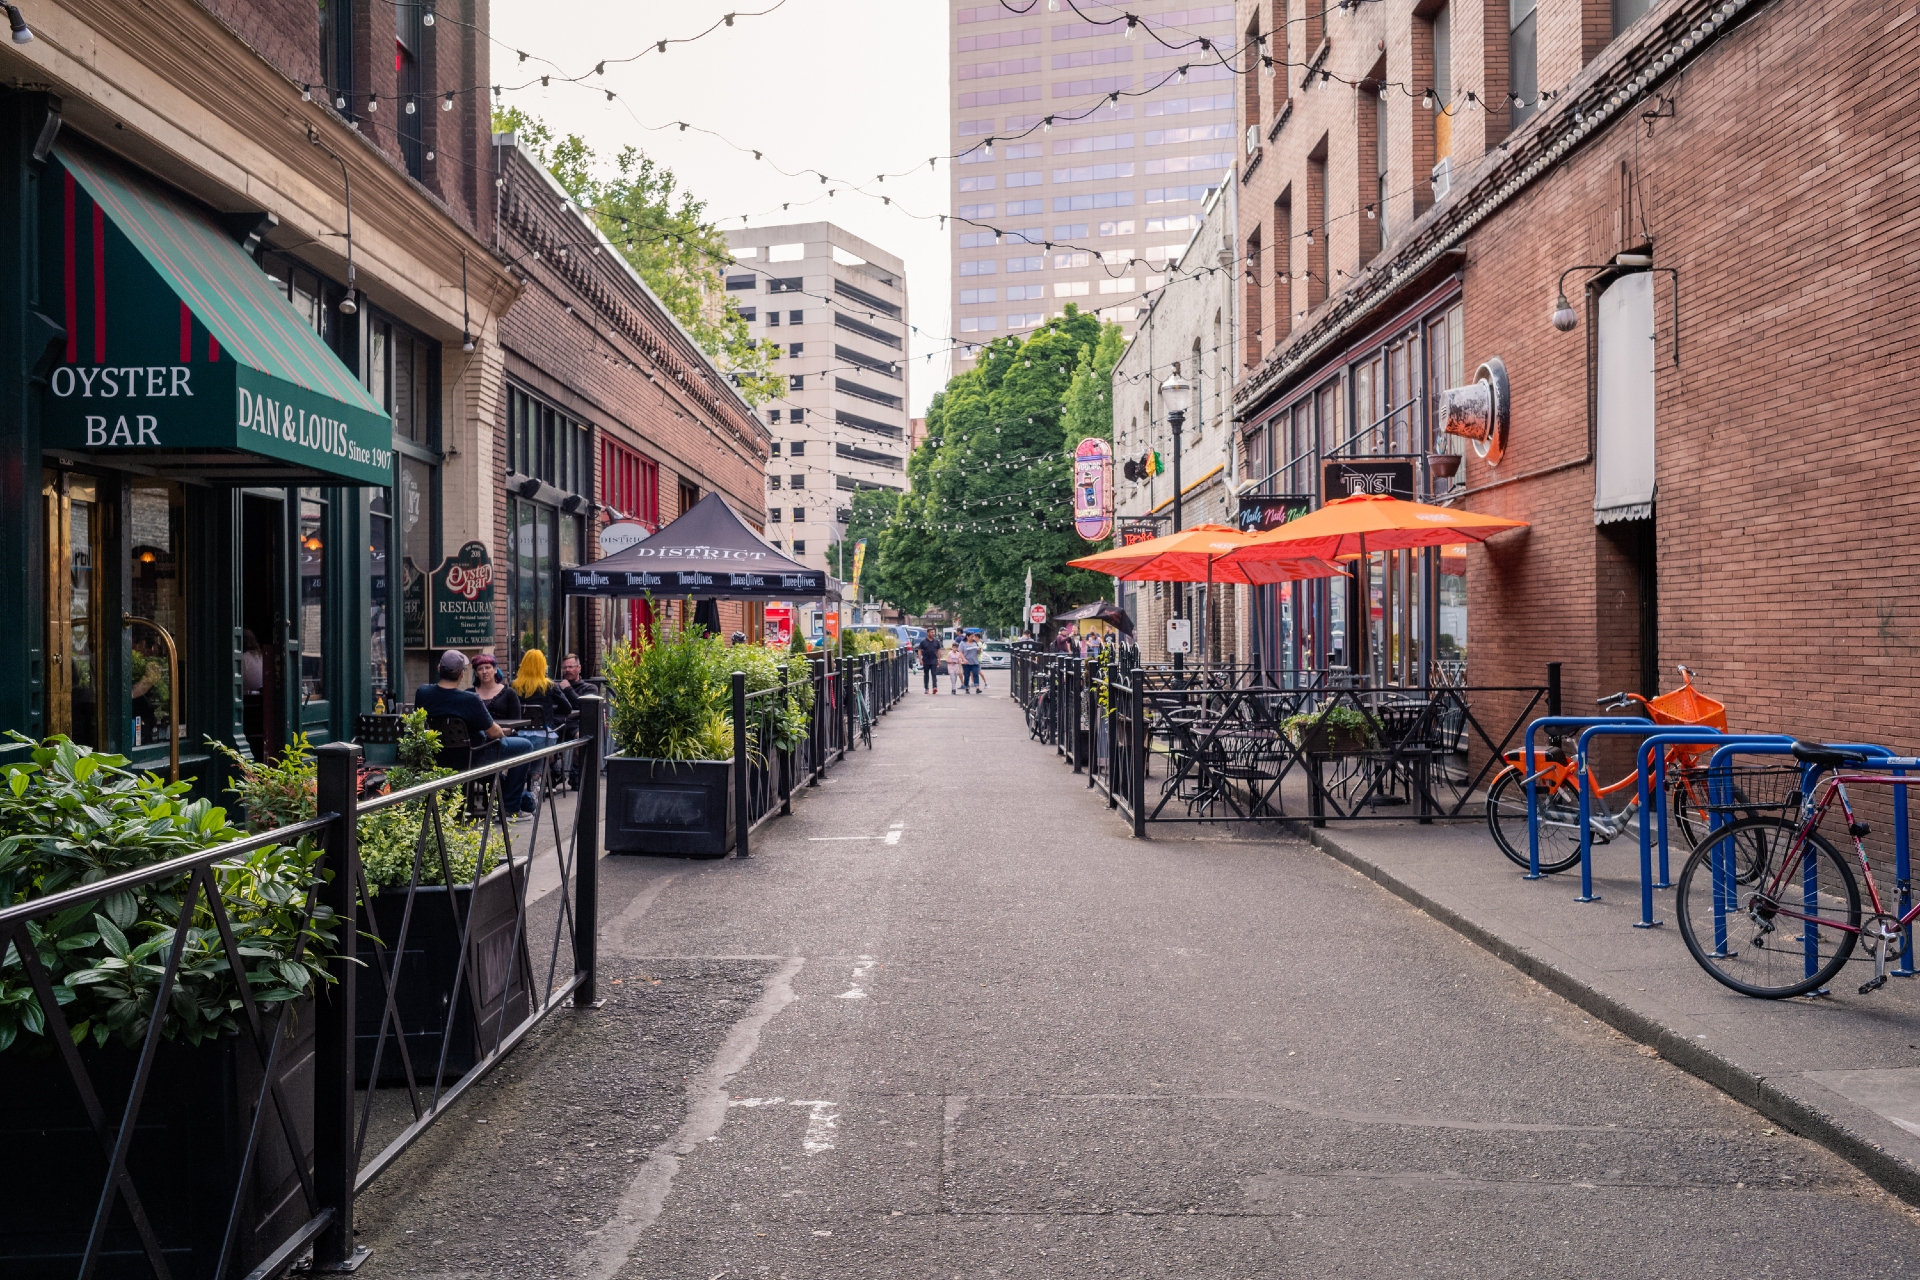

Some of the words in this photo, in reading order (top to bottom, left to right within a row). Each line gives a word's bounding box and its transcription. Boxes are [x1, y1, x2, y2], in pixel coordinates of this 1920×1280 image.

[51, 366, 194, 398] OYSTER
[85, 414, 162, 446] BAR
[238, 386, 279, 438] DAN
[281, 405, 297, 443] &
[299, 408, 348, 458] LOUIS
[348, 439, 371, 465] Since
[371, 447, 392, 470] 1907
[1343, 472, 1397, 494] TRYST
[1239, 505, 1263, 526] Nails
[1264, 505, 1287, 525] Nails
[470, 550, 481, 558] 208
[636, 548, 767, 560] DISTRICT
[446, 563, 493, 591] Oyster
[462, 578, 486, 599] Bar
[446, 636, 464, 644] LOUIS
